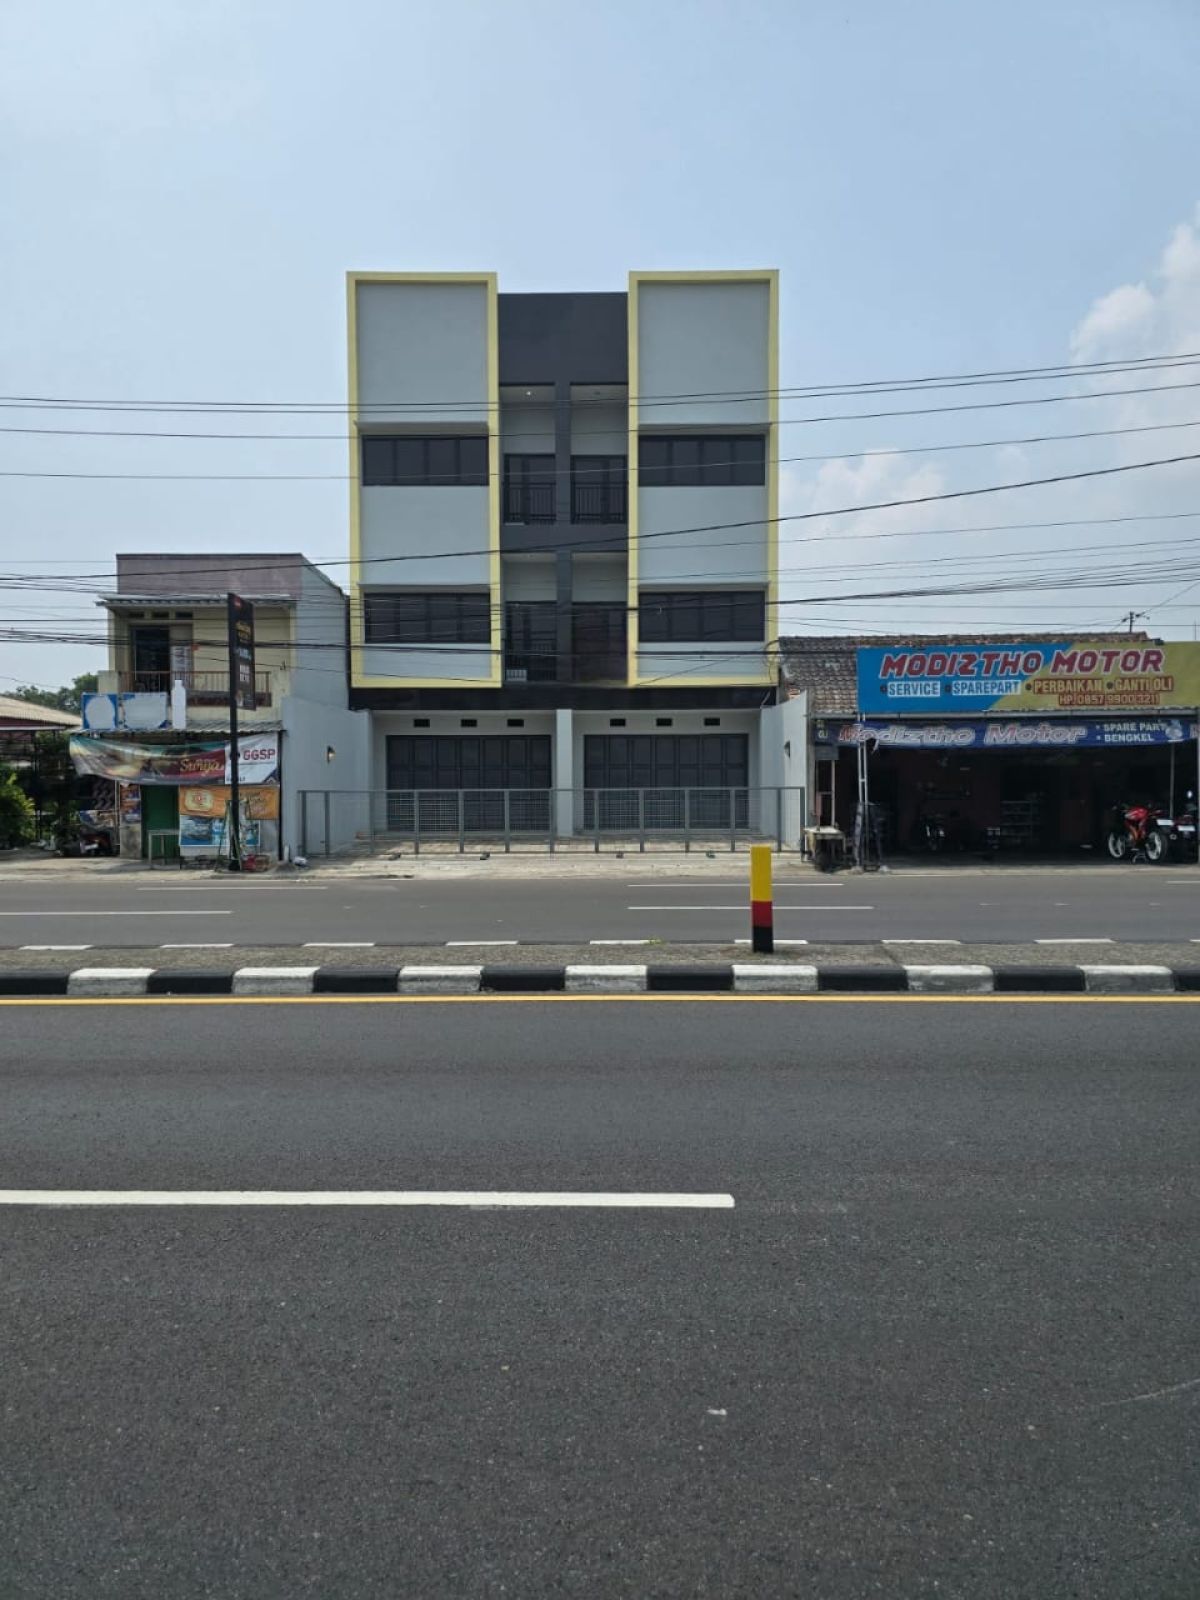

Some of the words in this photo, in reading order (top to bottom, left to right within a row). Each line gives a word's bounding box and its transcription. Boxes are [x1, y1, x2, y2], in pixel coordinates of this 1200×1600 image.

[879, 651, 1043, 678] MODIZTHO
[1050, 648, 1165, 675] MOTOR
[888, 682, 939, 696] SERVICE
[953, 680, 1020, 695] SPAREPART
[1034, 679, 1102, 693] PERBAIKAN
[1115, 678, 1150, 692] GANTI
[1153, 677, 1173, 691] OLI
[984, 722, 1087, 745] Motor
[1103, 722, 1137, 732] SPARE
[1139, 721, 1168, 731] PART
[1104, 733, 1155, 742] BENGKEL
[243, 748, 276, 761] GGSP
